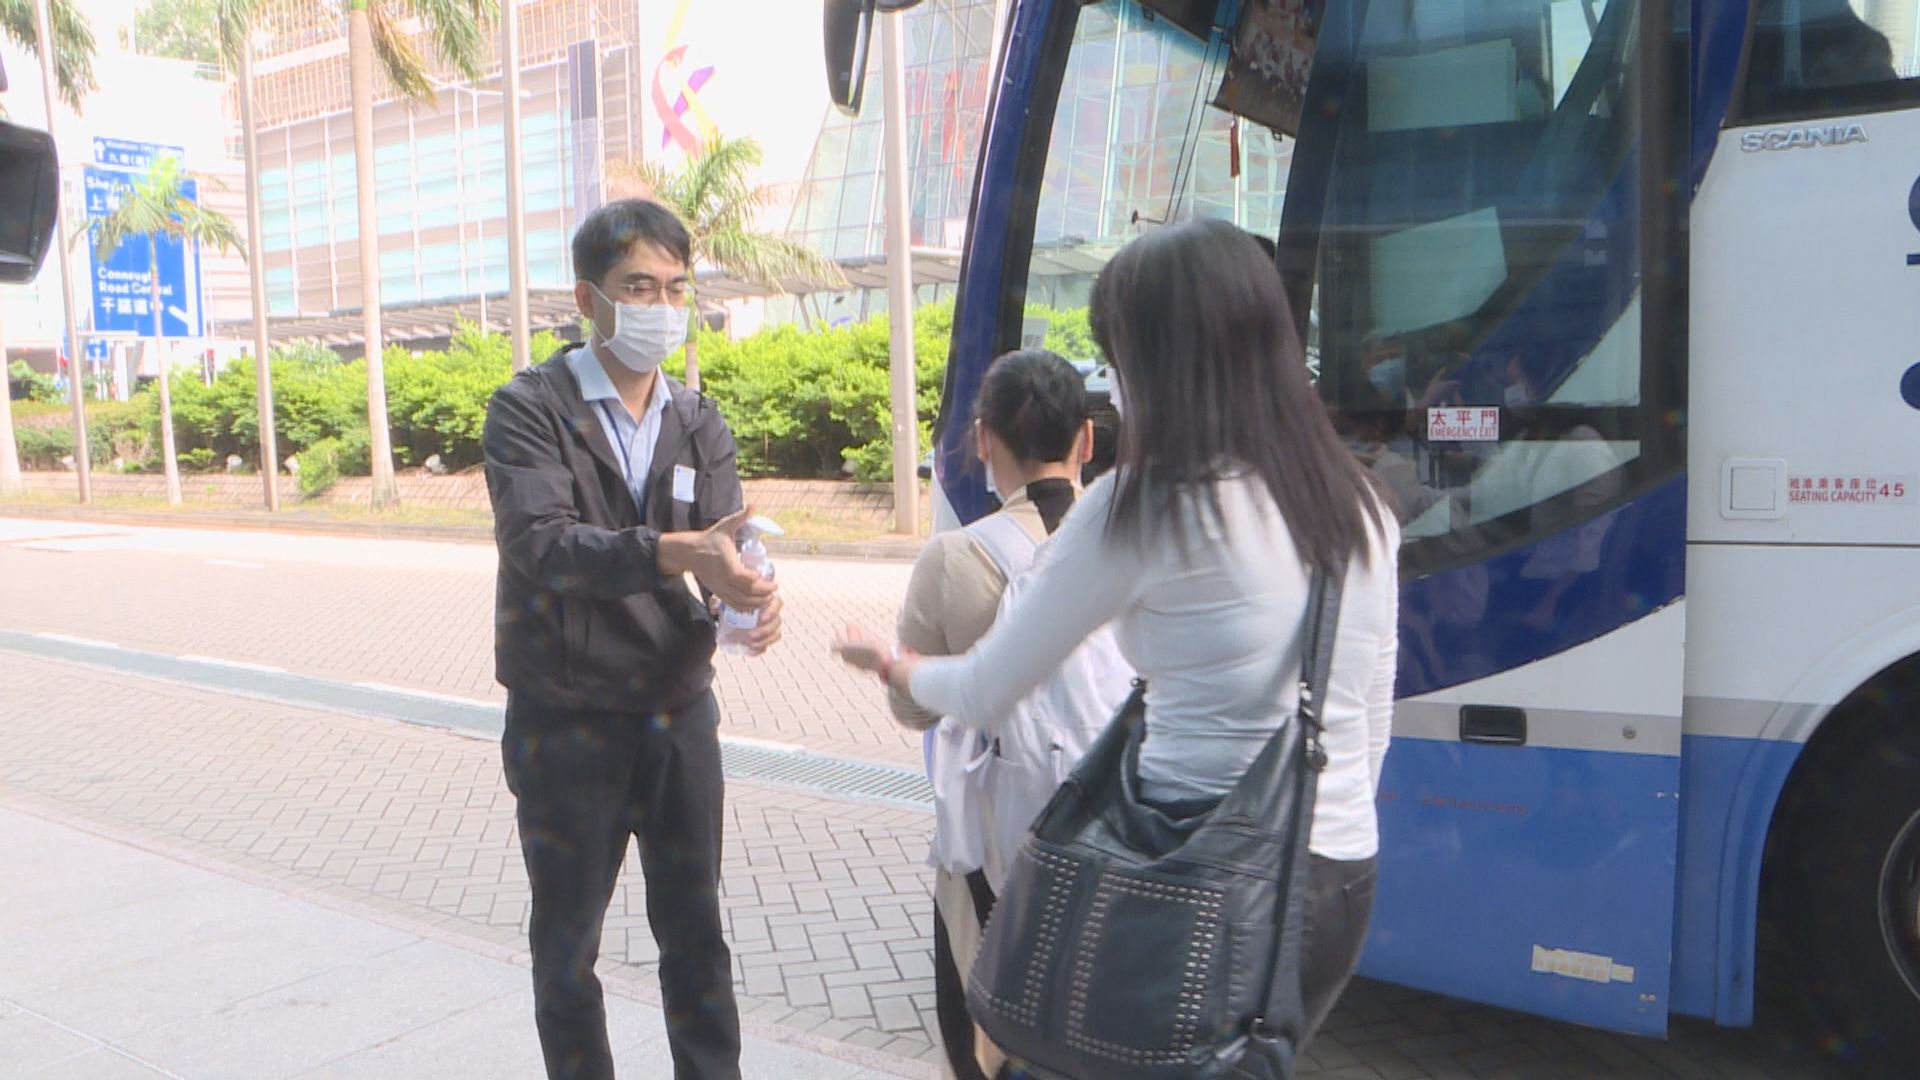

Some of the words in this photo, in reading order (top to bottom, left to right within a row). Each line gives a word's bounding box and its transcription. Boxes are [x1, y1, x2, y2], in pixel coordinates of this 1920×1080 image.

[1741, 123, 1868, 152] SCANIA
[98, 267, 155, 283] Connaug
[99, 281, 129, 293] Road
[131, 282, 173, 295] Cenal
[1431, 410, 1497, 425] 太平門
[1430, 427, 1477, 437] EMERGENCY
[1479, 427, 1496, 437] EXIT
[1789, 491, 1828, 502] SEATING
[1831, 492, 1877, 503] CAPACITY
[1879, 482, 1905, 498] 45
